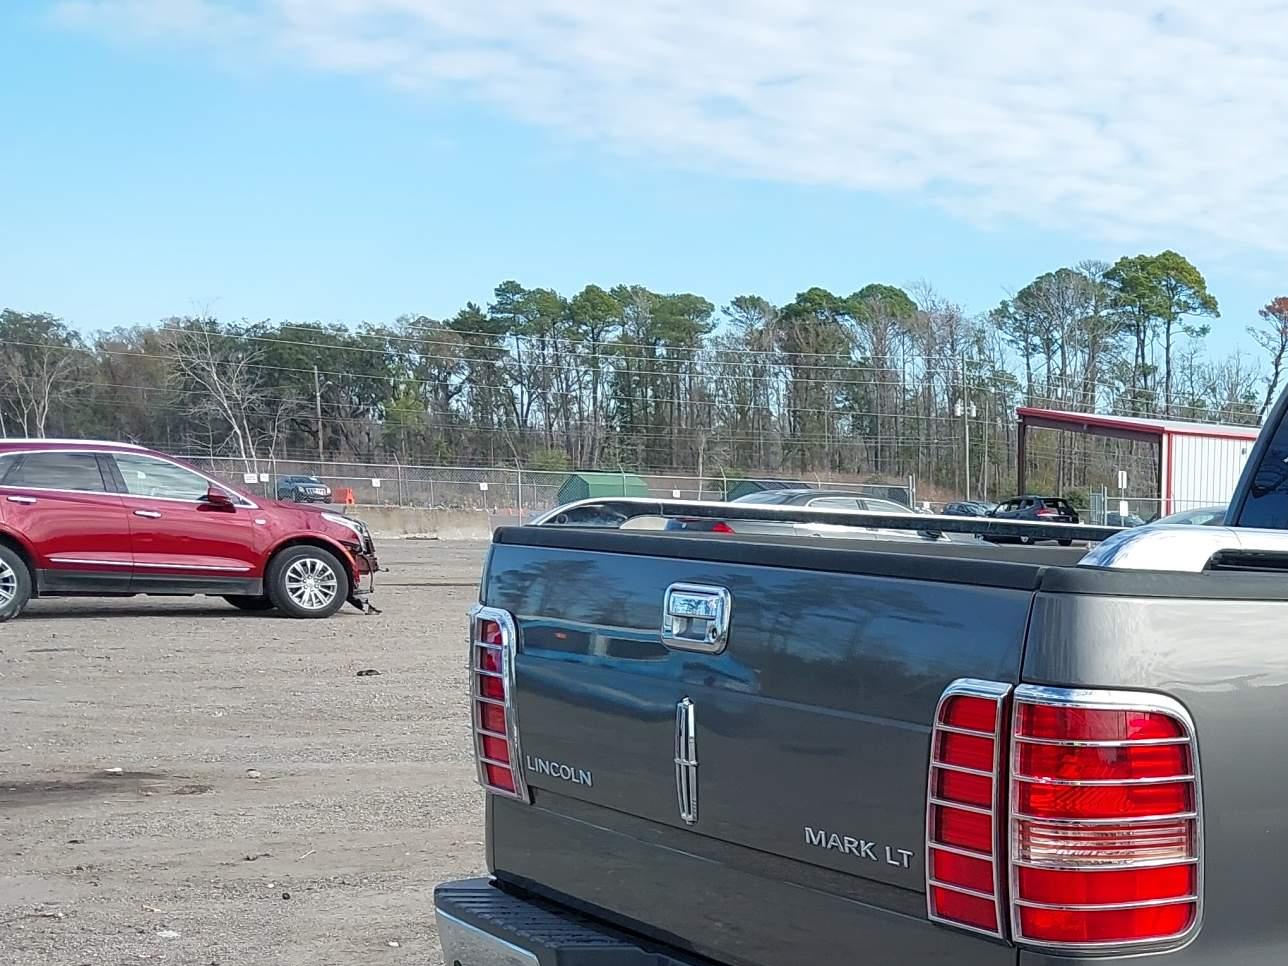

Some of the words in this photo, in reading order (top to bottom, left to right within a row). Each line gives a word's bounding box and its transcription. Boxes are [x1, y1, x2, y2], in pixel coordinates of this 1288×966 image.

[526, 755, 592, 787] LINCOLN
[804, 826, 878, 861] MARK
[885, 846, 914, 868] LT
